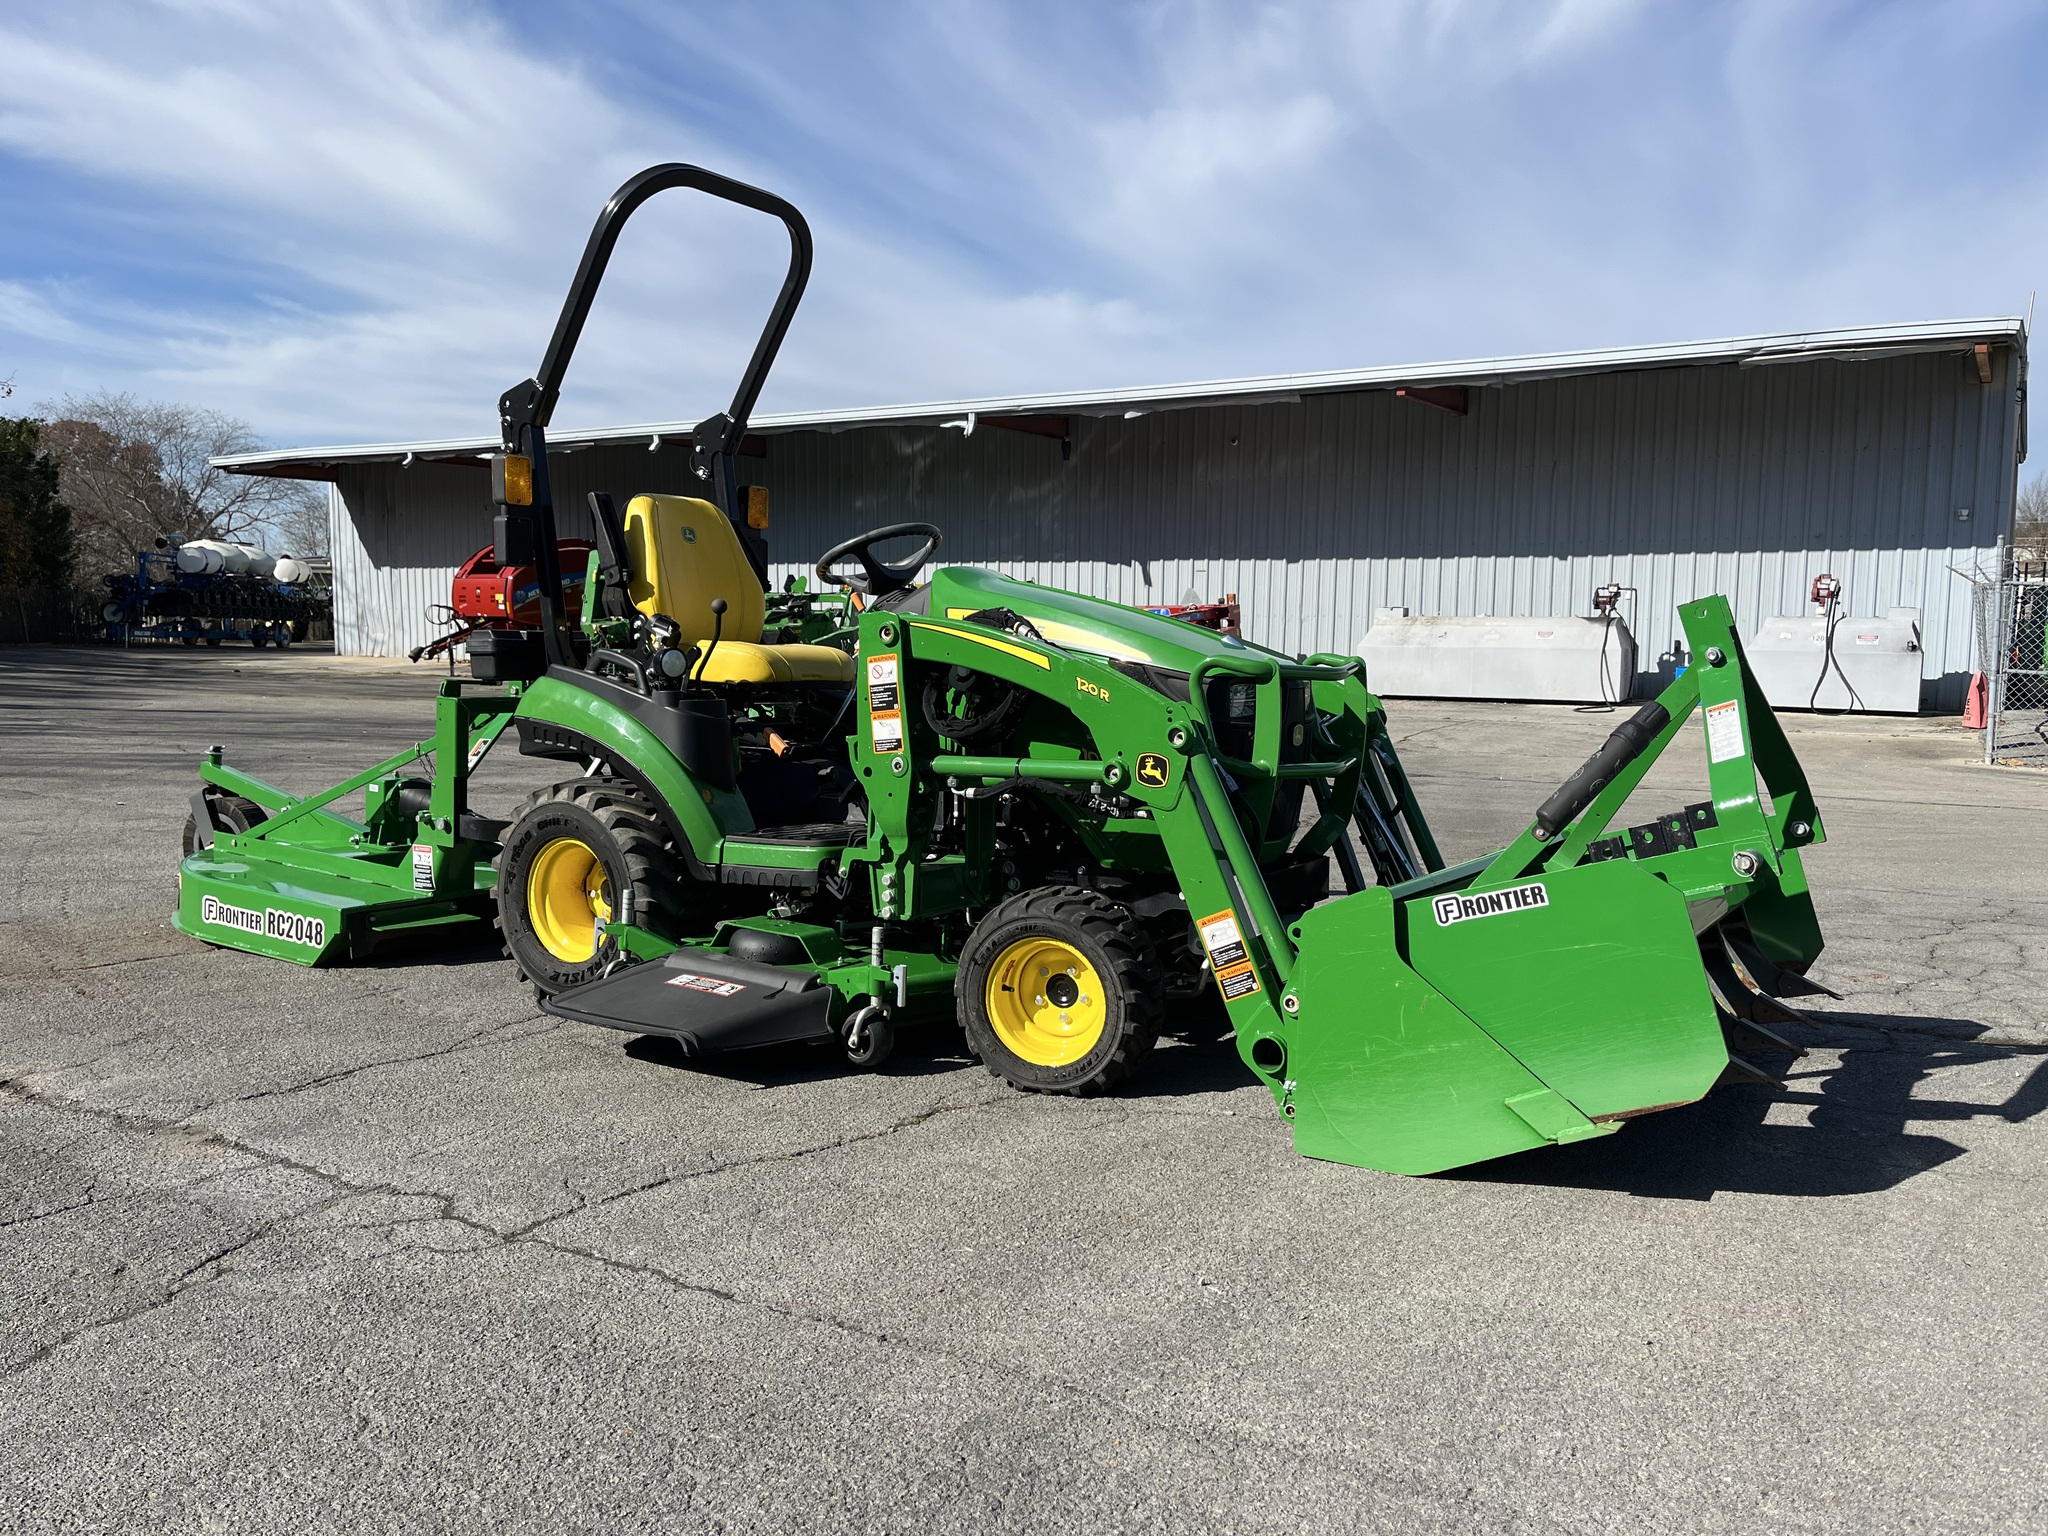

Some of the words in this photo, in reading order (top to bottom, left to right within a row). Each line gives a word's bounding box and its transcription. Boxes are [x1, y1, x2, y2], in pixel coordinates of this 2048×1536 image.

[877, 712, 899, 720] WARNING
[537, 817, 571, 831] CHIEF
[1435, 885, 1546, 924] FRONTIER
[204, 898, 263, 932] FRONTIER
[267, 911, 324, 946] RC2048
[1206, 912, 1229, 923] WARNING
[1226, 965, 1249, 976] WARNING
